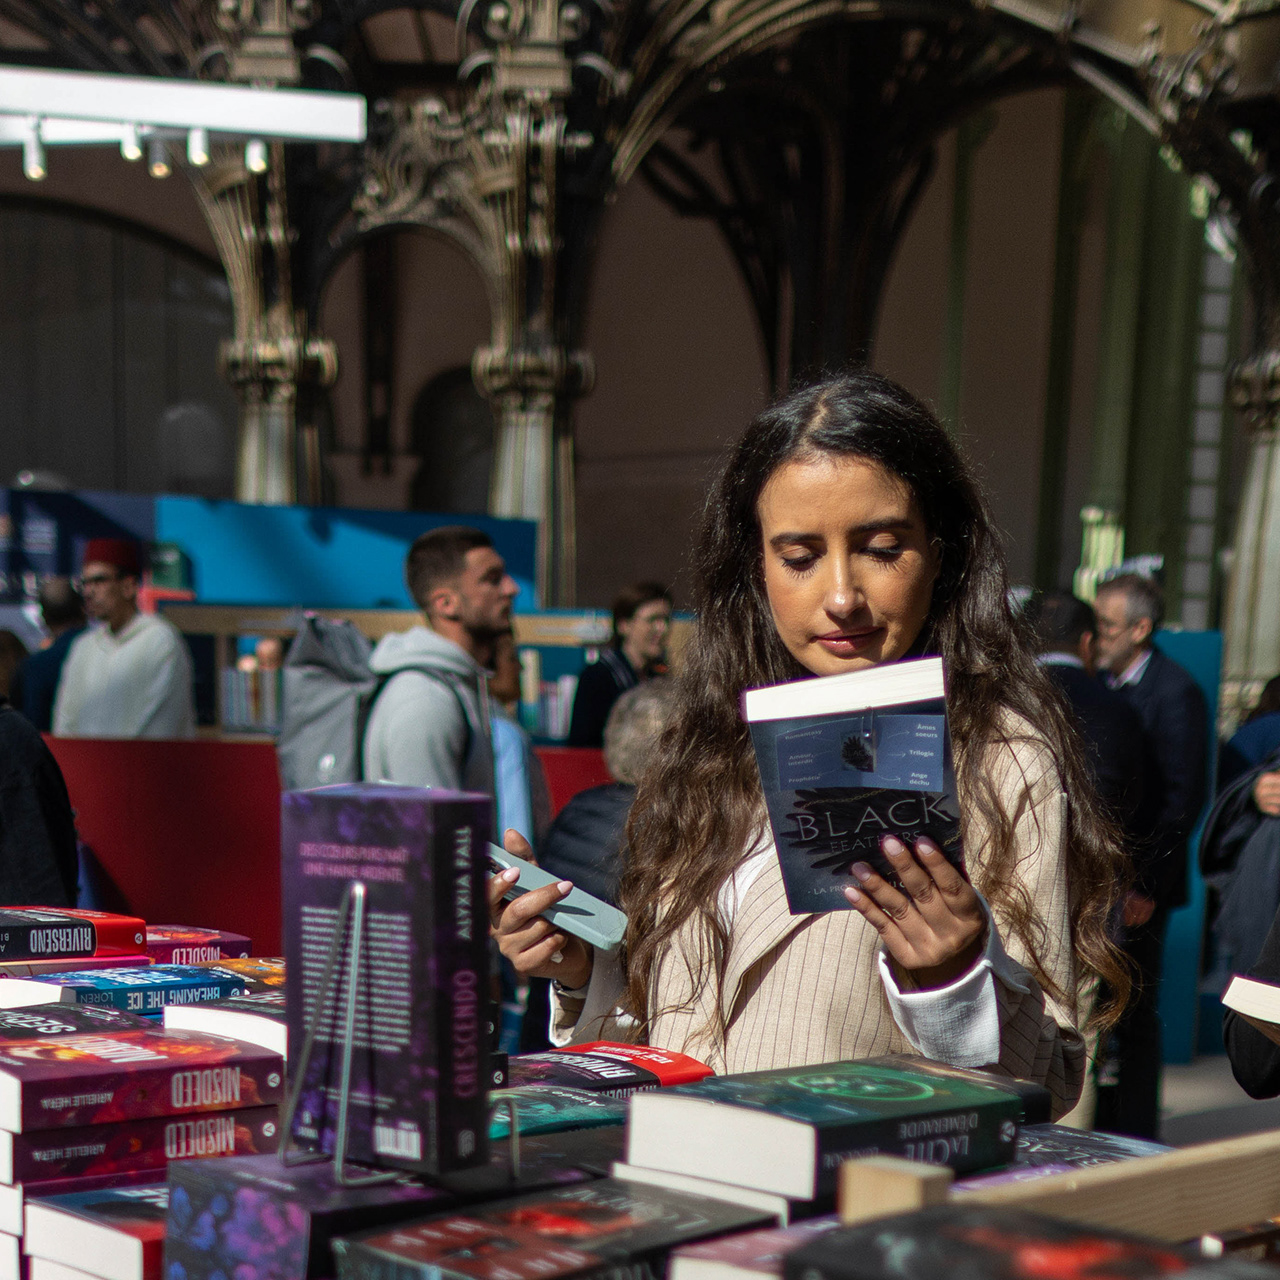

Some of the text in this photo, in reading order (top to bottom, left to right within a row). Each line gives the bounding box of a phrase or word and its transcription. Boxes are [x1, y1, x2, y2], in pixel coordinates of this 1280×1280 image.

[909, 749, 934, 757] Trilogie
[788, 775, 821, 783] Prophétie
[911, 772, 928, 780] Ange
[796, 794, 952, 841] BLACK
[830, 830, 920, 853] FEATHRS
[30, 926, 91, 954] RIVERSEND
[452, 826, 478, 1098] CRESCENDO ALYXIA FALL
[80, 991, 113, 1004] LOREN
[127, 986, 220, 1011] BREAKING THE ICE
[72, 1090, 114, 1107] ARIELLE
[171, 1067, 241, 1108] MISDEED
[165, 1117, 235, 1159] MISDEED
[951, 1135, 970, 1156] LA
[64, 1143, 106, 1158] ARIELLE
